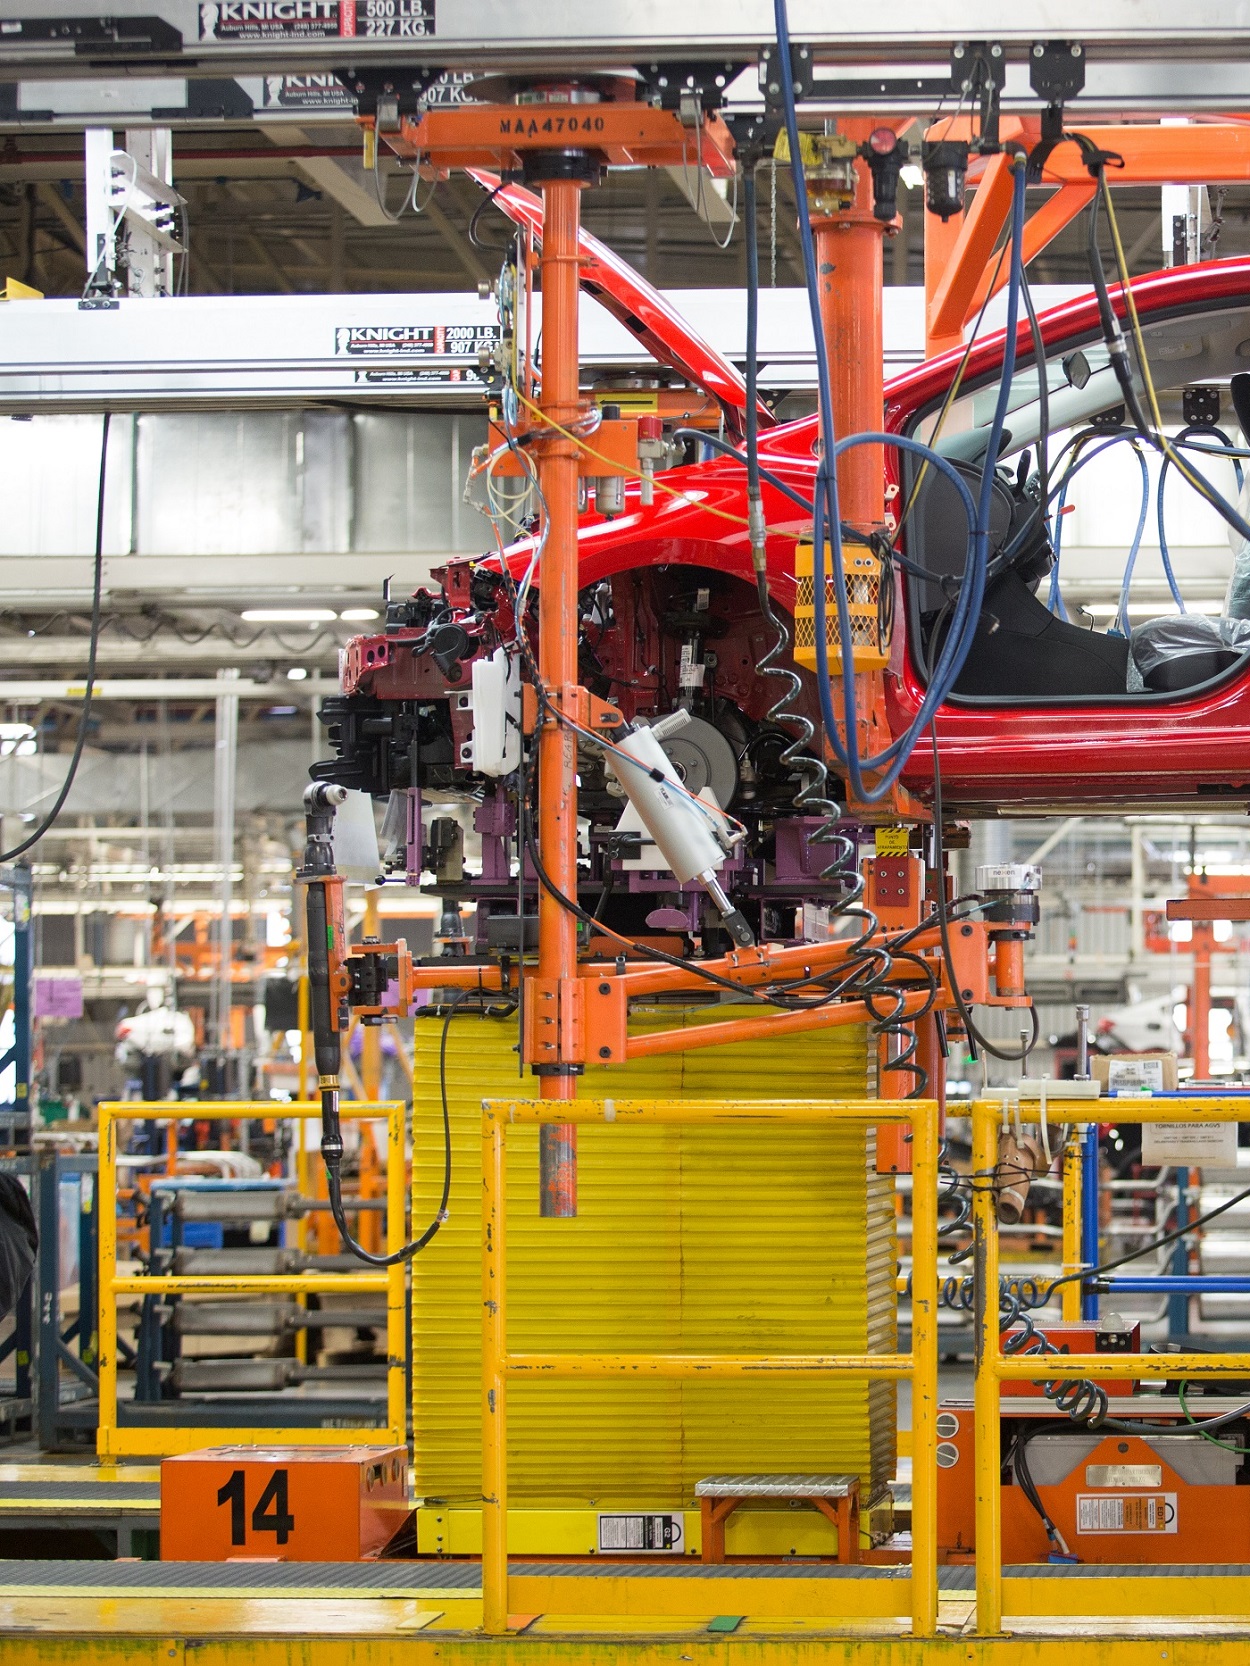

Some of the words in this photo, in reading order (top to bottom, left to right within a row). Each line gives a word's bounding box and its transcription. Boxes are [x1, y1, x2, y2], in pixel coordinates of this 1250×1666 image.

[221, 1, 335, 20] KNIGHT
[366, 1, 395, 17] 500
[399, 0, 428, 16] LB.
[221, 24, 244, 32] Auburn
[270, 23, 284, 31] USA
[366, 21, 393, 37] 227
[400, 19, 430, 36] KG.
[239, 31, 326, 39] www.knight-ind.com
[286, 74, 345, 87] KNI
[302, 97, 359, 105] www.knight-in
[500, 116, 604, 135] MAA47040
[351, 327, 434, 341] KNIGHT
[446, 328, 473, 339] 2000
[477, 327, 497, 339] LB.
[451, 342, 473, 354] 907
[217, 1469, 295, 1546] 14
[664, 1527, 671, 1538] G2
